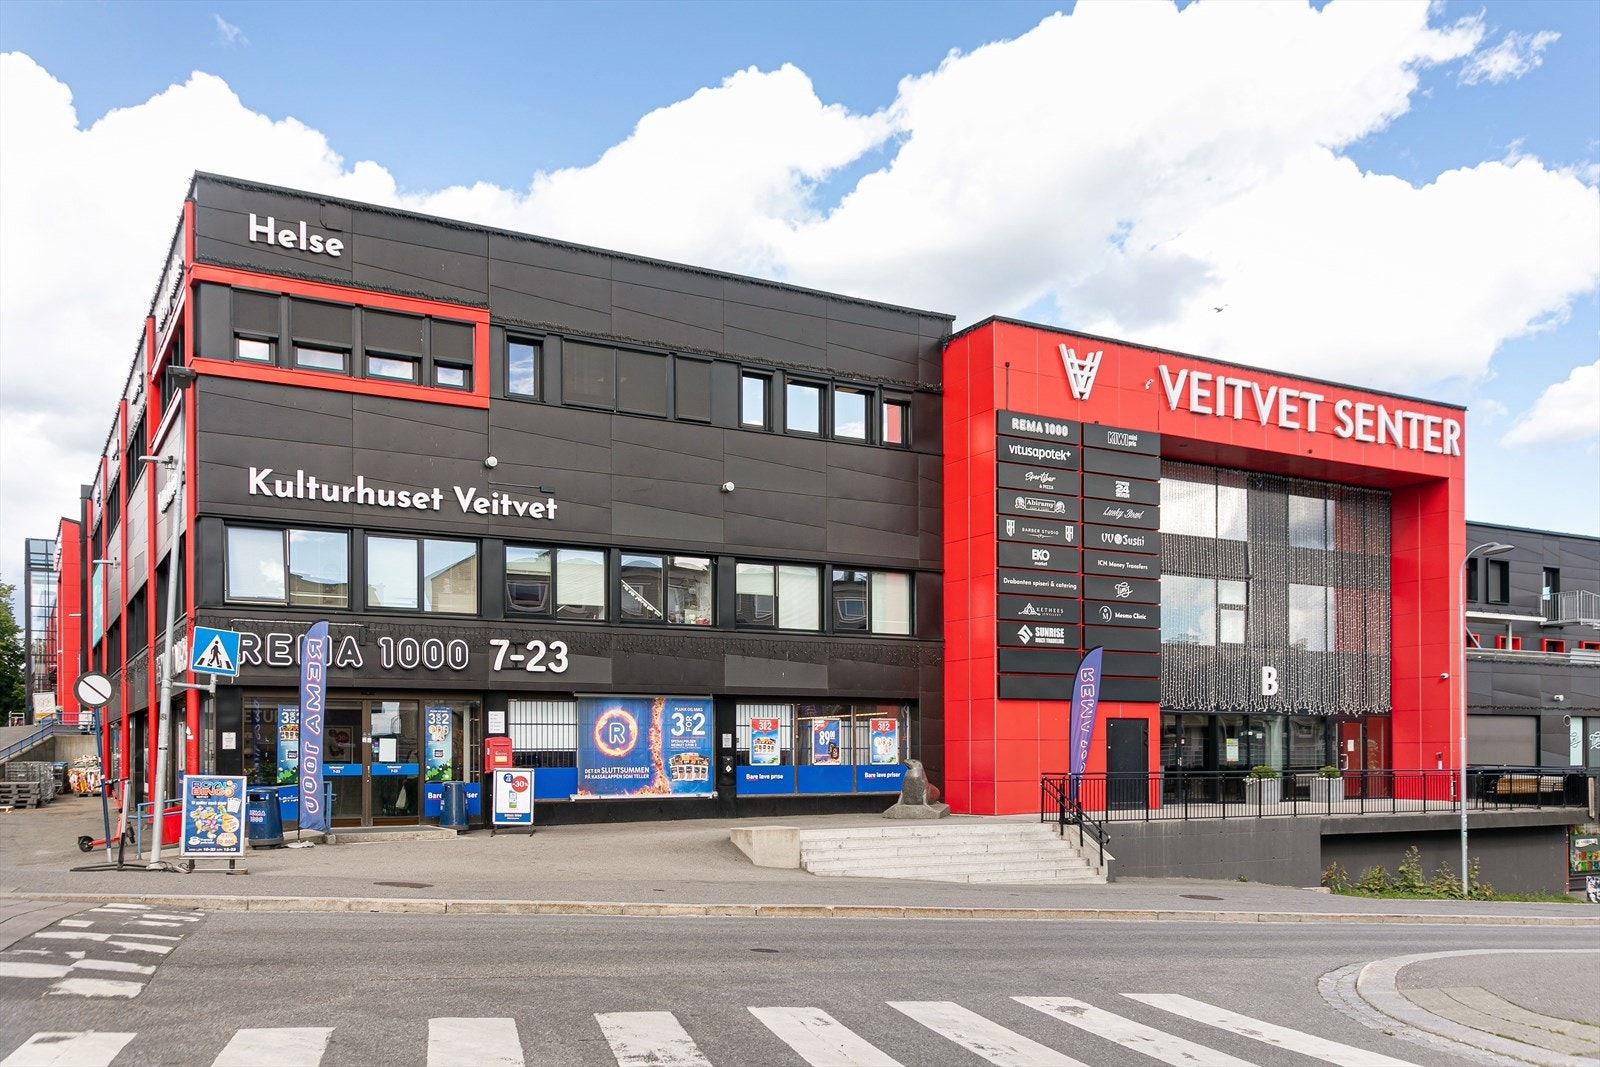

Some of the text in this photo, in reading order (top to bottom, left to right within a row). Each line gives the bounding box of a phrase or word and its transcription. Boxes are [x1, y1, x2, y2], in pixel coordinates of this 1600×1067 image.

[249, 213, 344, 257] Helse
[1158, 364, 1461, 456] VEITVET SENTER
[1011, 417, 1069, 437] REMA 1000
[1107, 431, 1128, 447] KIWI
[249, 466, 557, 520] Kulturhuset Veitvet
[1115, 484, 1130, 494] 24
[1026, 499, 1054, 509] Abiramy
[1031, 549, 1050, 562] EKO
[1097, 559, 1148, 570] ICN Money Transfers
[1003, 577, 1032, 586] Drabanten
[1033, 579, 1049, 588] spiseri
[1055, 581, 1077, 590] catering
[1133, 612, 1147, 620] Clinic
[1035, 626, 1065, 638] SUNRISE
[377, 636, 469, 670] 1000
[489, 639, 568, 673] 7-23
[306, 638, 322, 735] REMA
[1261, 666, 1279, 696] B
[1080, 667, 1095, 733] REMA
[609, 722, 626, 744] R
[671, 712, 685, 736] 3
[692, 712, 706, 736] 2
[601, 766, 650, 774] SLUTTSUMMEN
